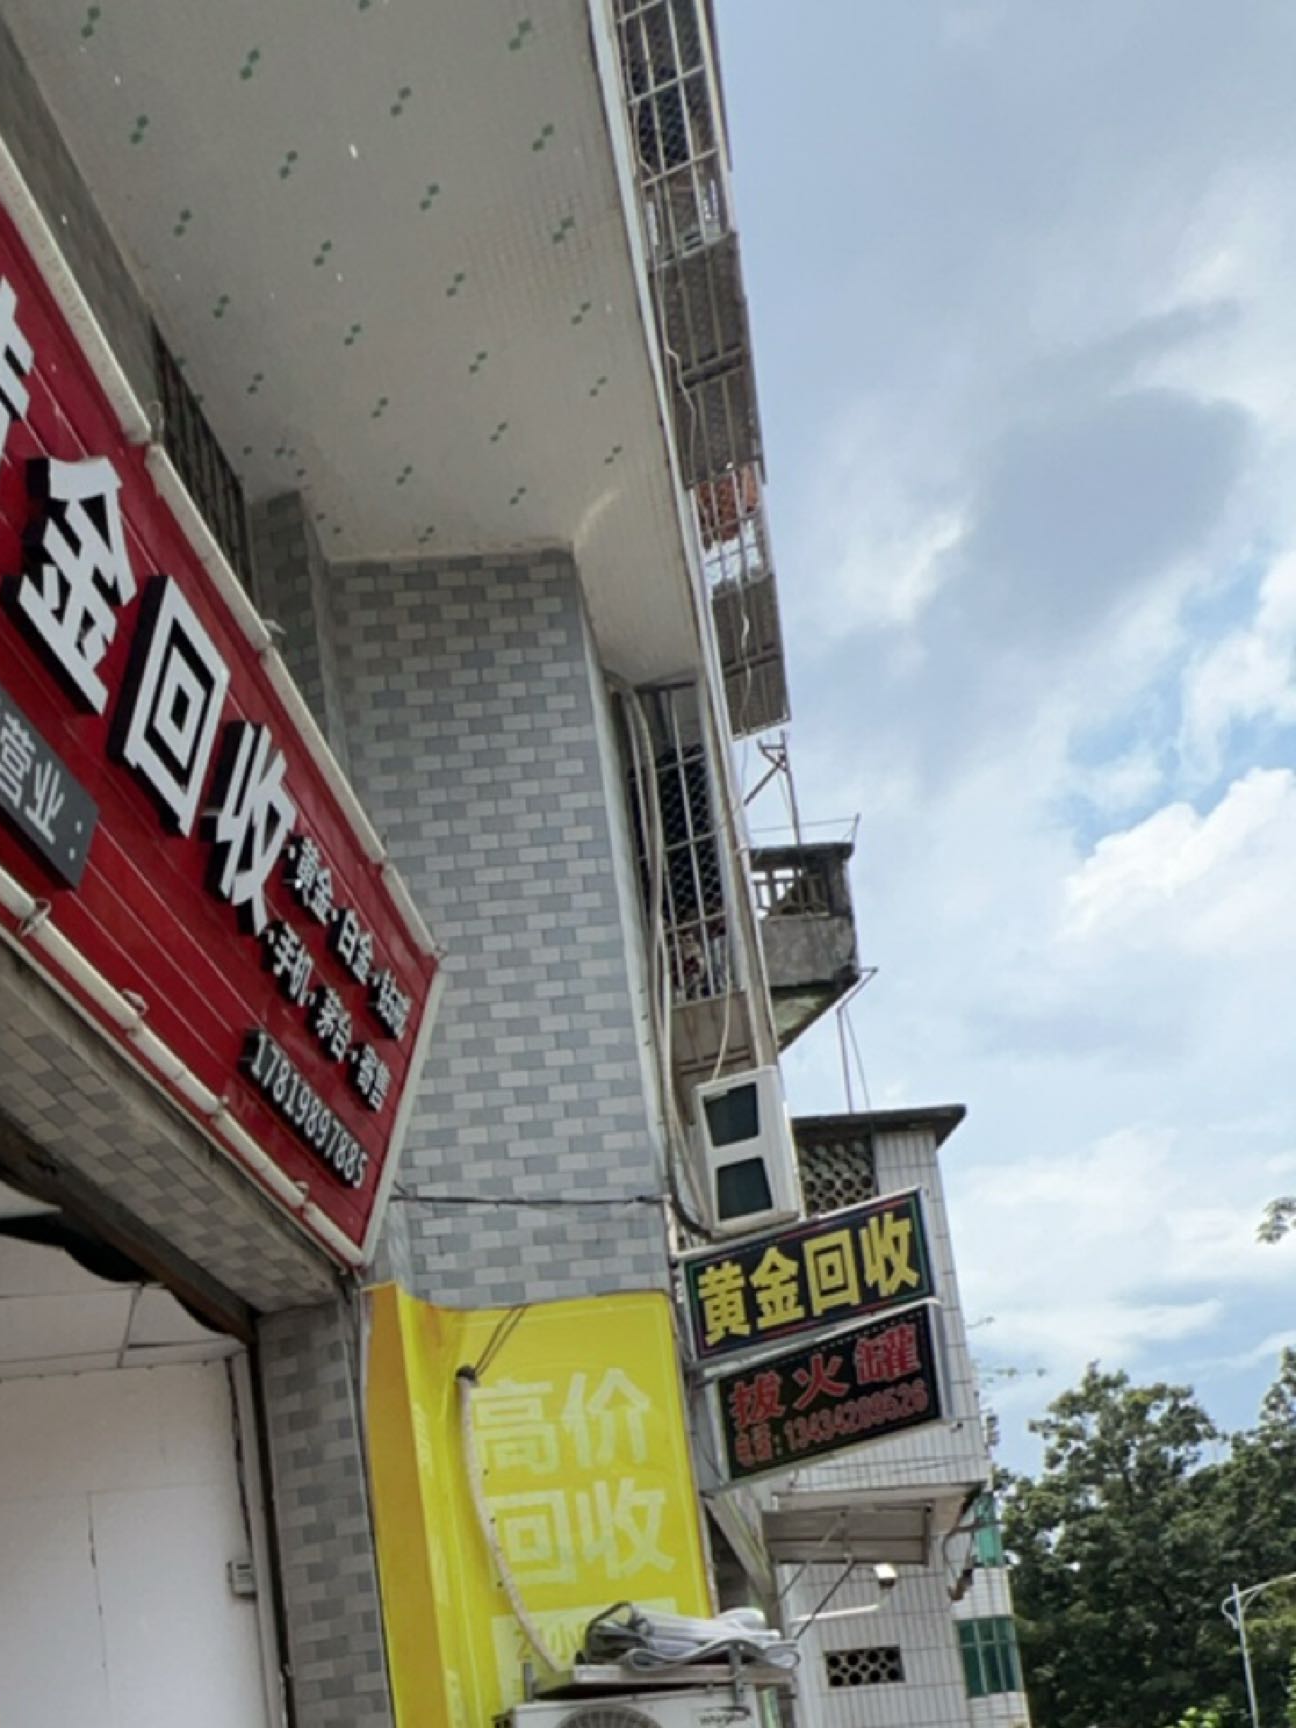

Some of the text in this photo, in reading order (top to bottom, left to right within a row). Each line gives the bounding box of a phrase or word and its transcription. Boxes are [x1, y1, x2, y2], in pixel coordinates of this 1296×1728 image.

[697, 1211, 920, 1347] 黄金回收
[471, 1367, 651, 1475] 高价
[487, 1477, 677, 1587] 回收
